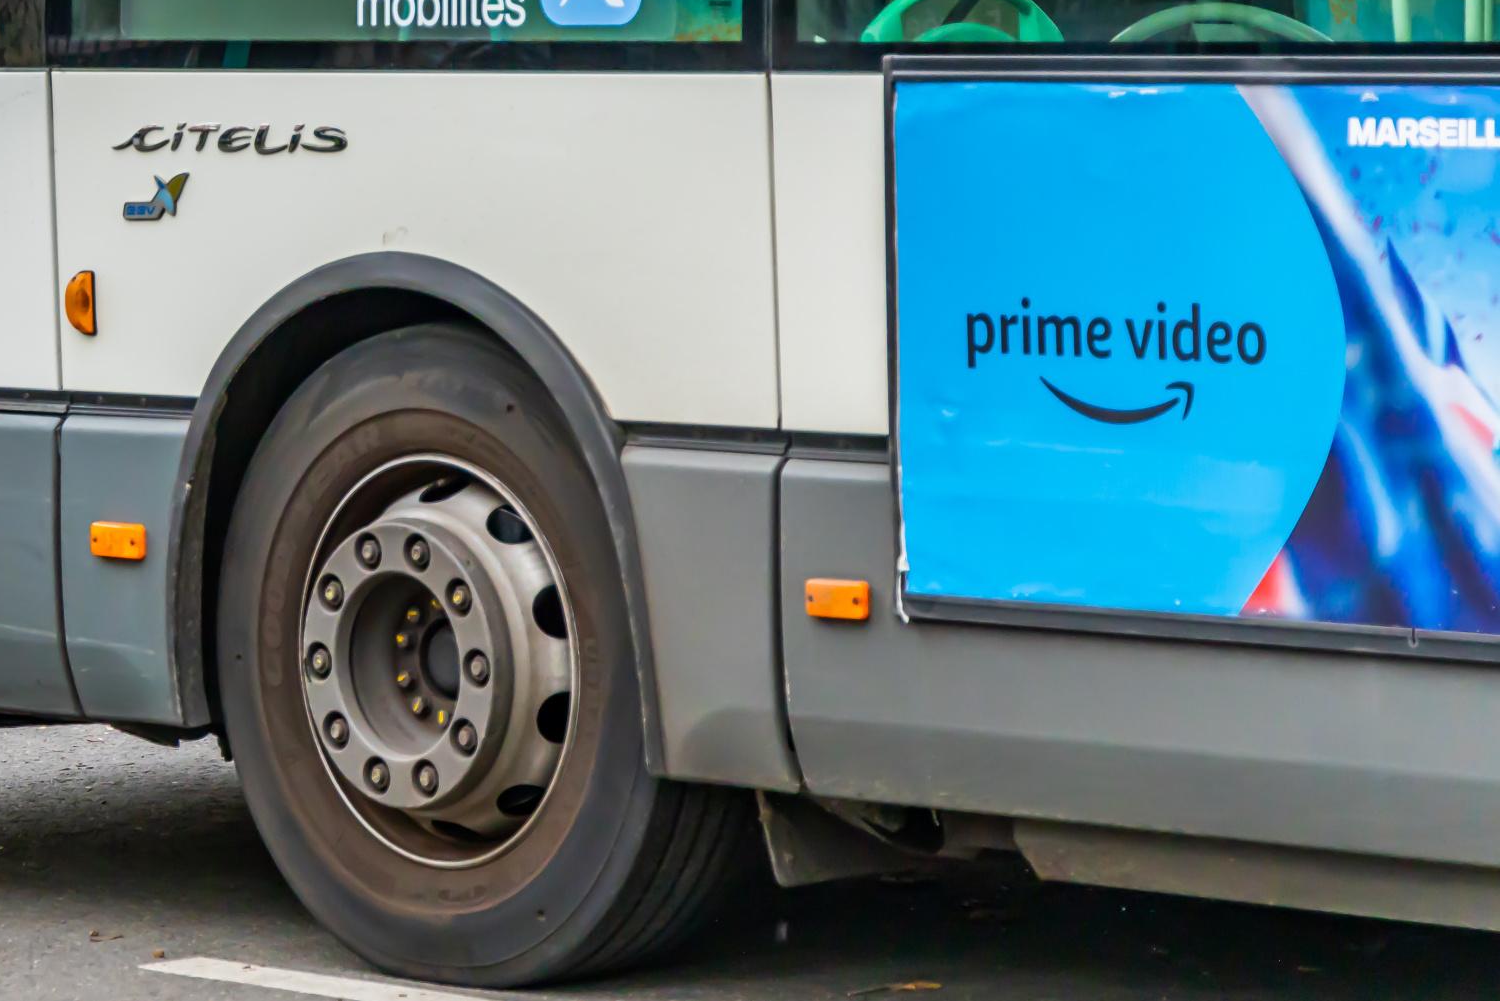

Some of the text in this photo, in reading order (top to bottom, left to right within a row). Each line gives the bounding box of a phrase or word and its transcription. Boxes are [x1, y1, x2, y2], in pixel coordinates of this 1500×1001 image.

[1347, 115, 1500, 148] MARSEILL
[966, 297, 1267, 369] prime video
